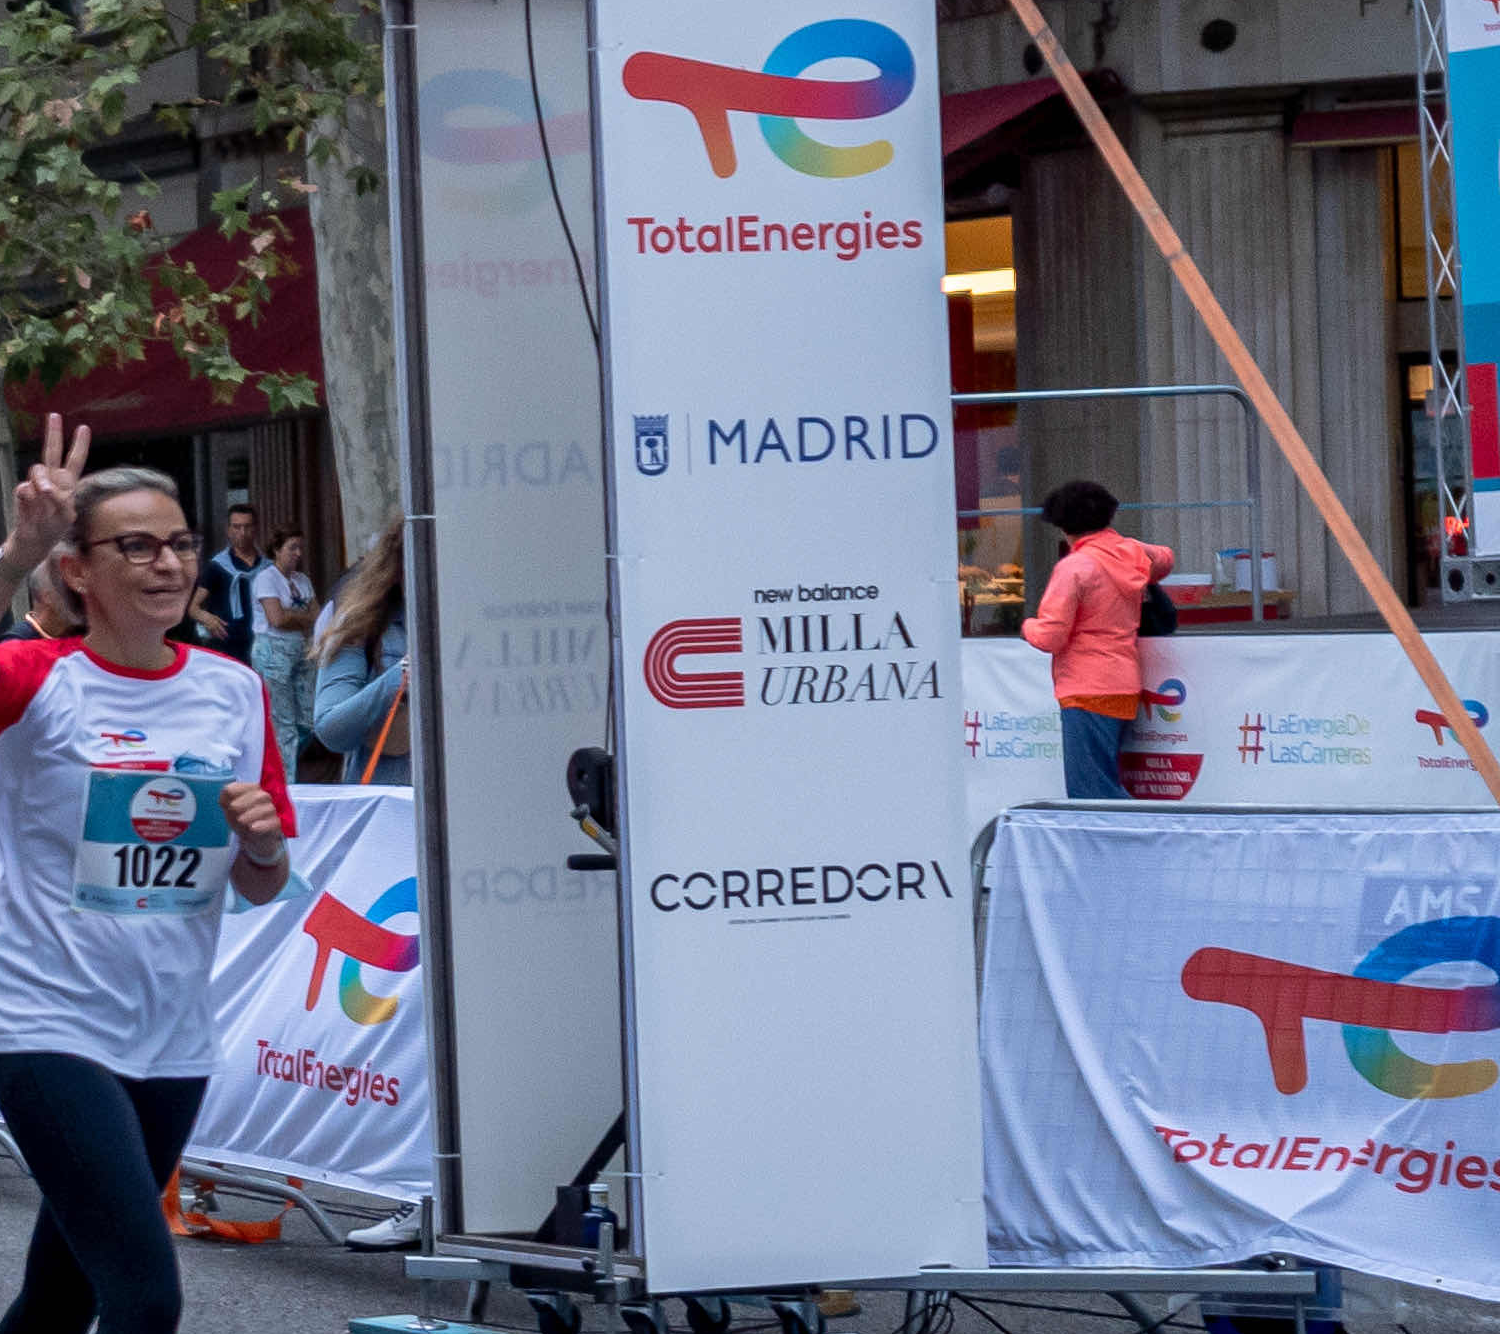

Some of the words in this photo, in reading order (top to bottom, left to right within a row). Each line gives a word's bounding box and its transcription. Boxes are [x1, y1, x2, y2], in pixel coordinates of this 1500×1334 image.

[627, 212, 924, 262] TotalEnergies
[707, 413, 940, 466] MADRID
[753, 586, 794, 605] new
[798, 583, 880, 604] balance
[756, 610, 917, 655] MILLA
[759, 659, 945, 708] URBANA
[1417, 756, 1479, 771] TotalEnerg
[114, 843, 203, 888] 1022
